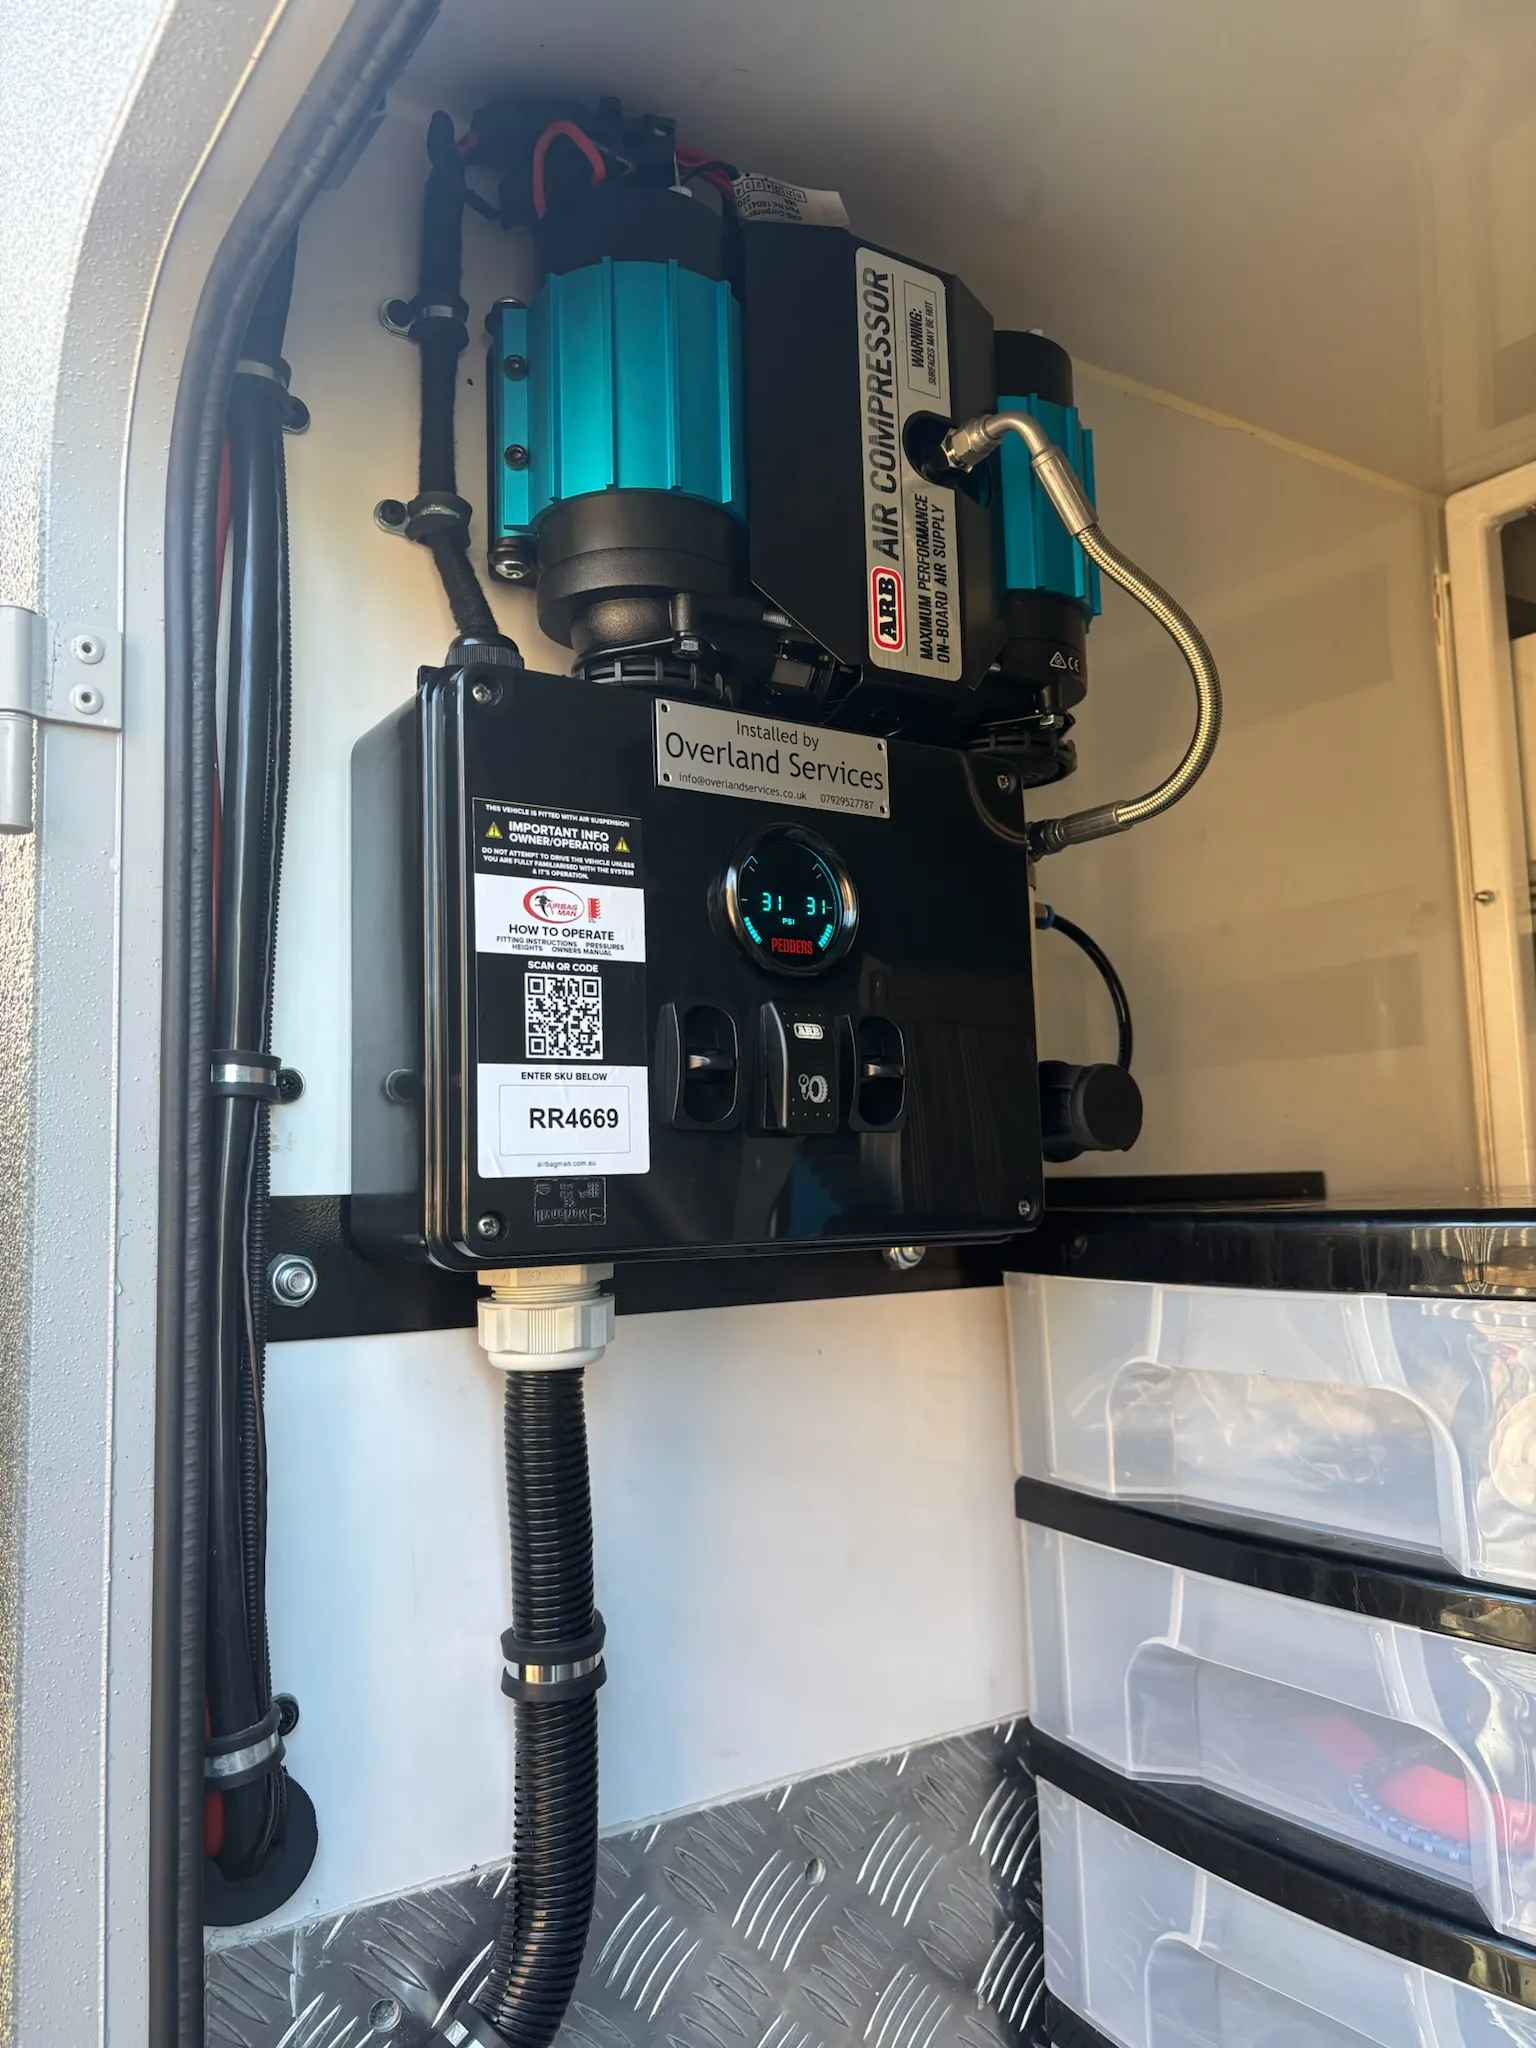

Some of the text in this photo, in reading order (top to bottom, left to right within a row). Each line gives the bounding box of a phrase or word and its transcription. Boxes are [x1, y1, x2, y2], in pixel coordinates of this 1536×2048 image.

[909, 308, 924, 368] WARNING:
[925, 300, 936, 386] SURFACES MAY BE HOT
[862, 267, 900, 561] AIR COMPRESSOR
[914, 494, 933, 660] MAXIMUM PERFORMANCE
[931, 504, 950, 663] ON-BOARD AIR SUPPLY
[878, 577, 898, 641] ARB
[736, 720, 819, 752] Installed by
[666, 732, 884, 790] Overland Services
[679, 772, 874, 810] info@overlandservices.co.uk 07929527787
[485, 804, 501, 812] THIS
[502, 806, 530, 816] VEHICLE
[538, 811, 560, 819] FITTED
[590, 817, 630, 828] SUSPENSION
[509, 820, 609, 842] IMPORTANT INFO
[509, 832, 610, 852] OWNER/OPERATOR
[494, 848, 508, 856] NOT
[509, 850, 539, 858] ATTEMPT
[550, 854, 570, 862] DRIVE
[570, 856, 584, 864] THE
[584, 858, 610, 866] VEHICLE
[611, 860, 635, 868] UNLESS
[514, 858, 534, 866] FULLY
[534, 860, 578, 870] FAMILIARISED
[597, 866, 610, 874] THE
[610, 868, 634, 876] SYSTEM
[551, 870, 590, 880] OPERATION.
[762, 892, 826, 916] 31 31
[509, 924, 614, 940] HOW TO OPERATE
[496, 936, 624, 950] FITTING INSTRUCTIONS PRESSURES
[512, 944, 612, 956] HEIGHTS OWNERS MANUAL
[770, 938, 814, 955] PEDDERS
[528, 960, 598, 973] SCAN QR CODE
[521, 1072, 608, 1080] ENTER SKU BELOW
[530, 1108, 618, 1128] RR4669
[537, 1160, 596, 1168] airbagman.com.au
